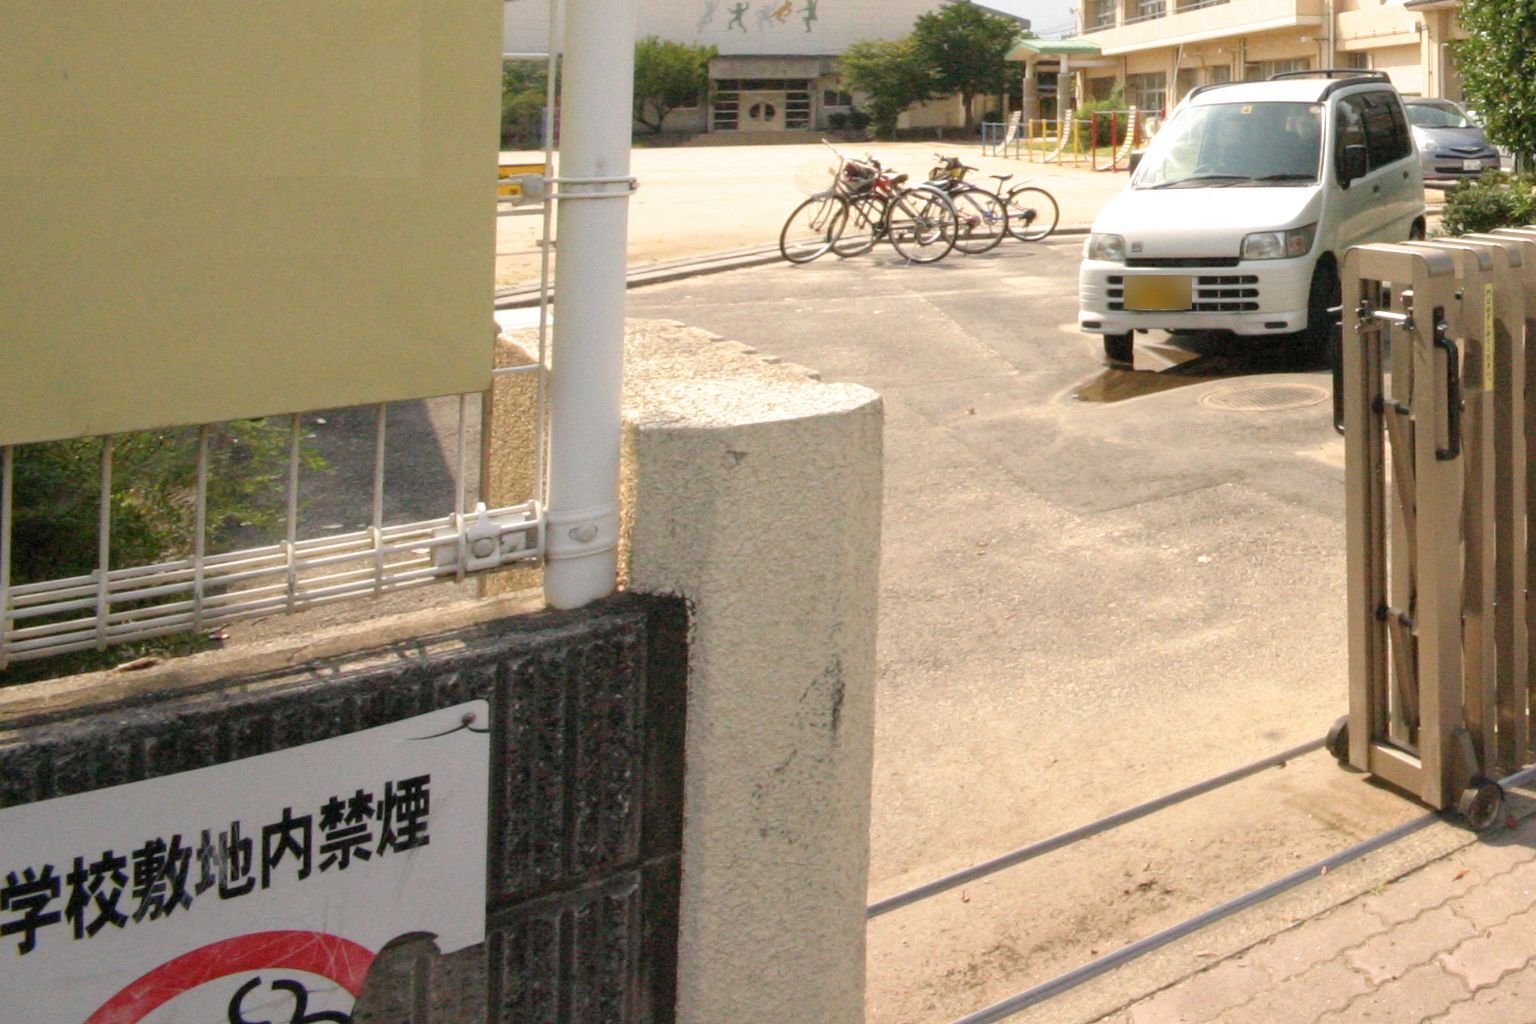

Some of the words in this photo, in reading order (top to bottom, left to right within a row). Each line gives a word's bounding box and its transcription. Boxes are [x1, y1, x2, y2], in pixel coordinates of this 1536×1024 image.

[0, 774, 431, 955] 学校敷地内禁煙
